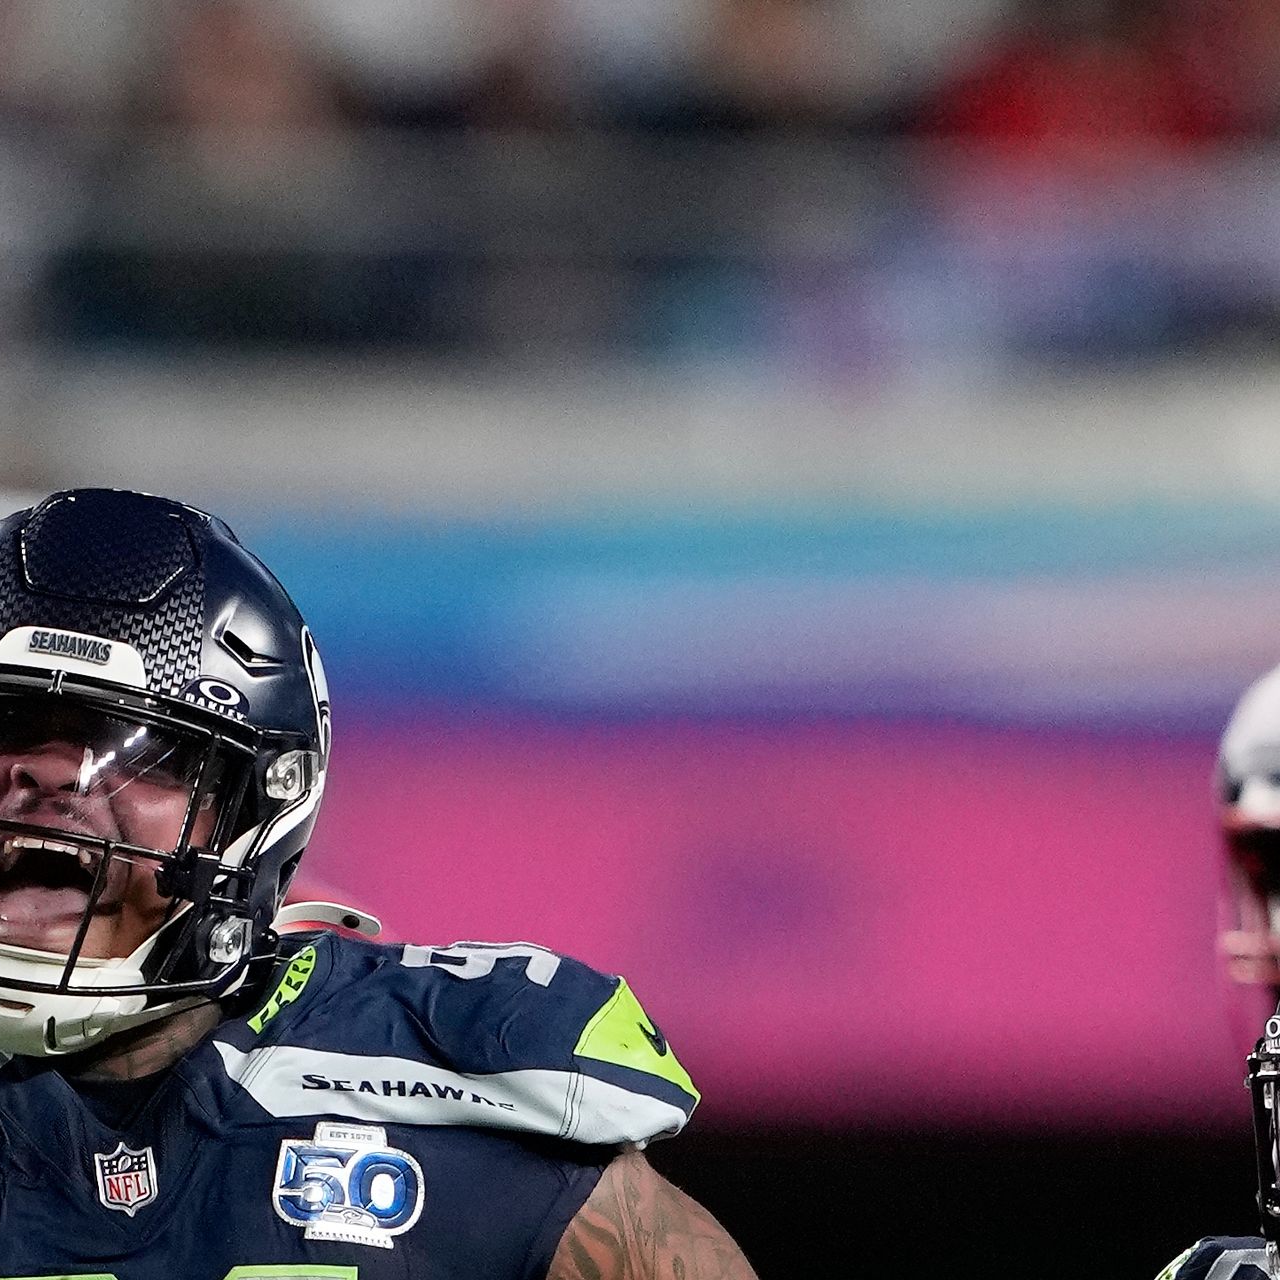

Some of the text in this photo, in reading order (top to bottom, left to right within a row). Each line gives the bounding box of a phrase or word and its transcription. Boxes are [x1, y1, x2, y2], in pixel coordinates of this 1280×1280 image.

[28, 629, 113, 665] SEAHAWKS
[106, 1174, 148, 1202] NFL
[276, 1144, 420, 1230] 50
